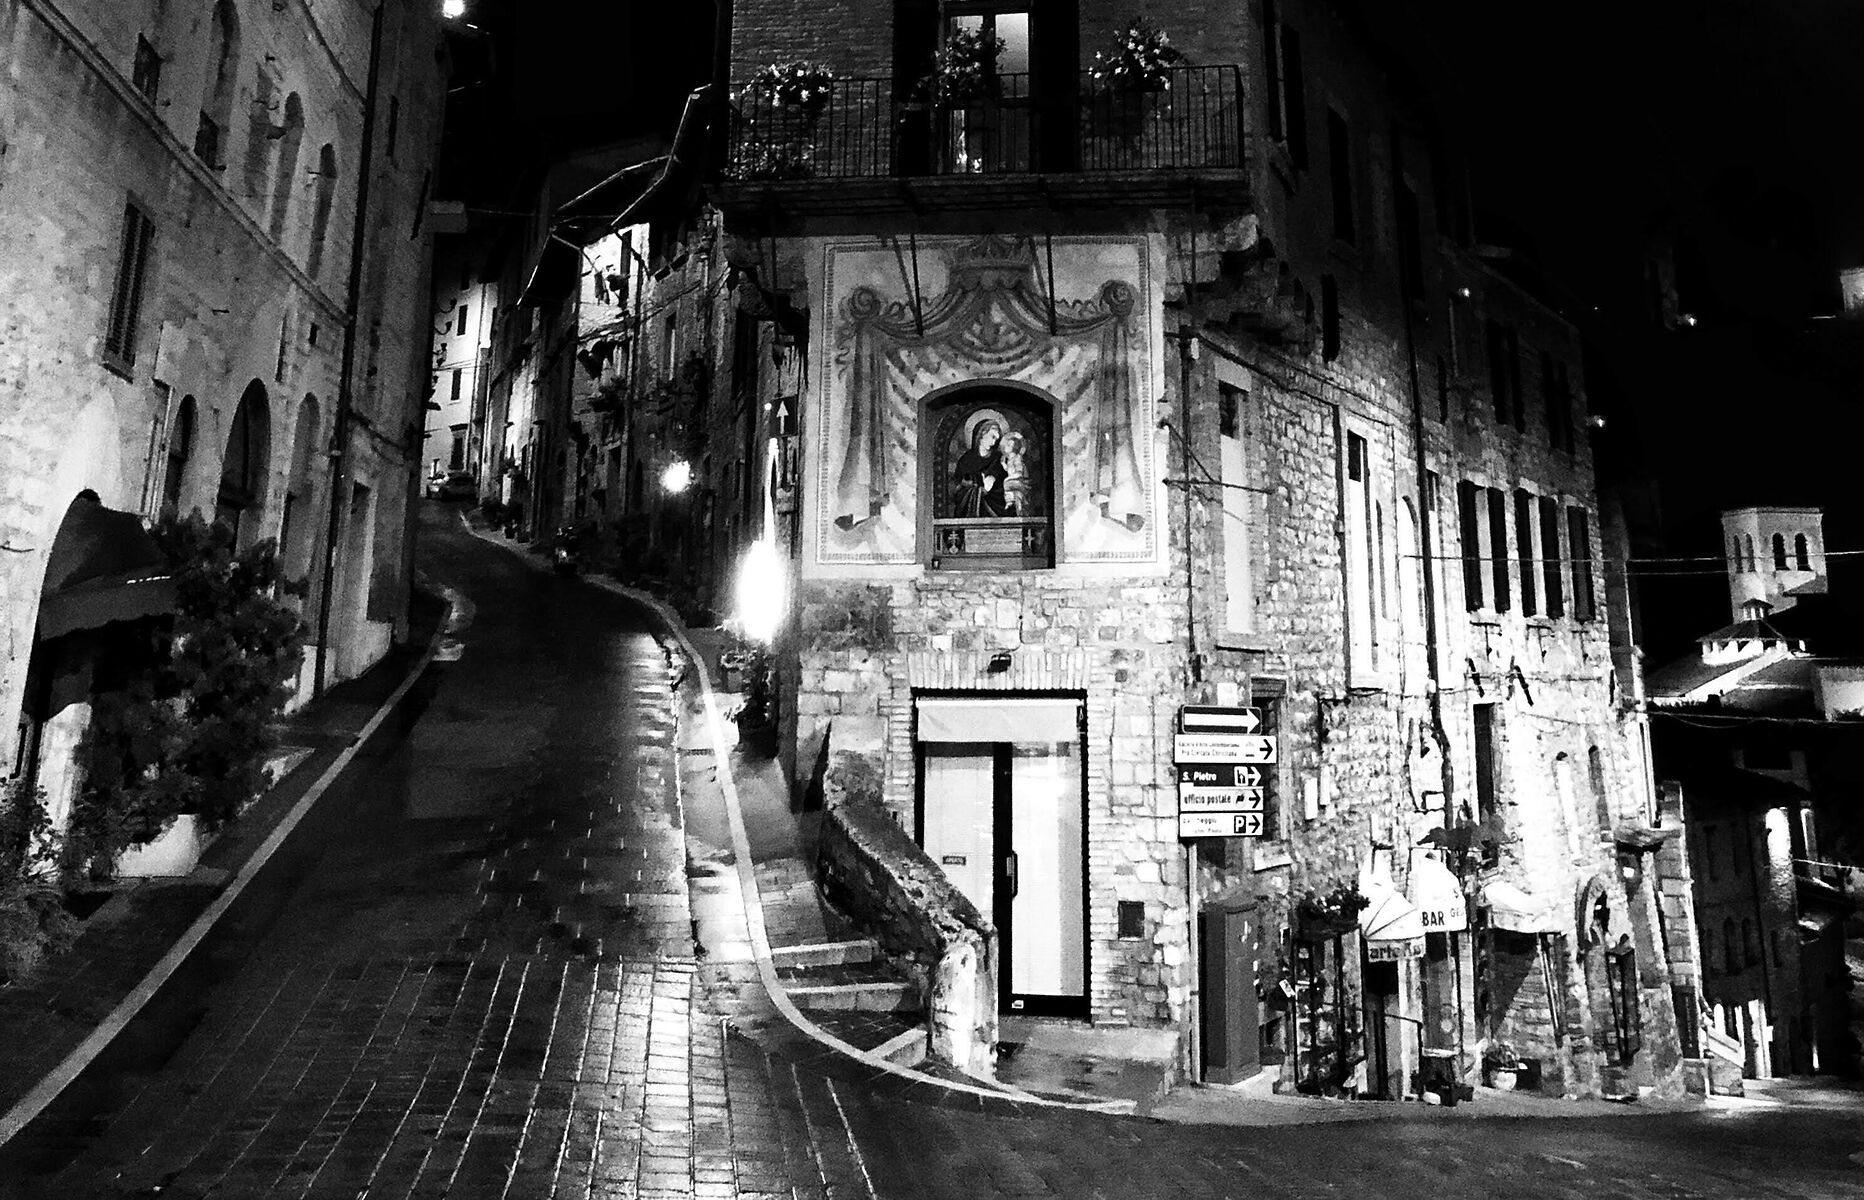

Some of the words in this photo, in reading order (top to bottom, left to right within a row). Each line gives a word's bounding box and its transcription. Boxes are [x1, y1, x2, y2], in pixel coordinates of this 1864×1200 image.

[1194, 771, 1217, 781] Pietro
[1184, 794, 1205, 804] ufficio
[1207, 794, 1231, 805] postale
[1421, 911, 1445, 926] BAR
